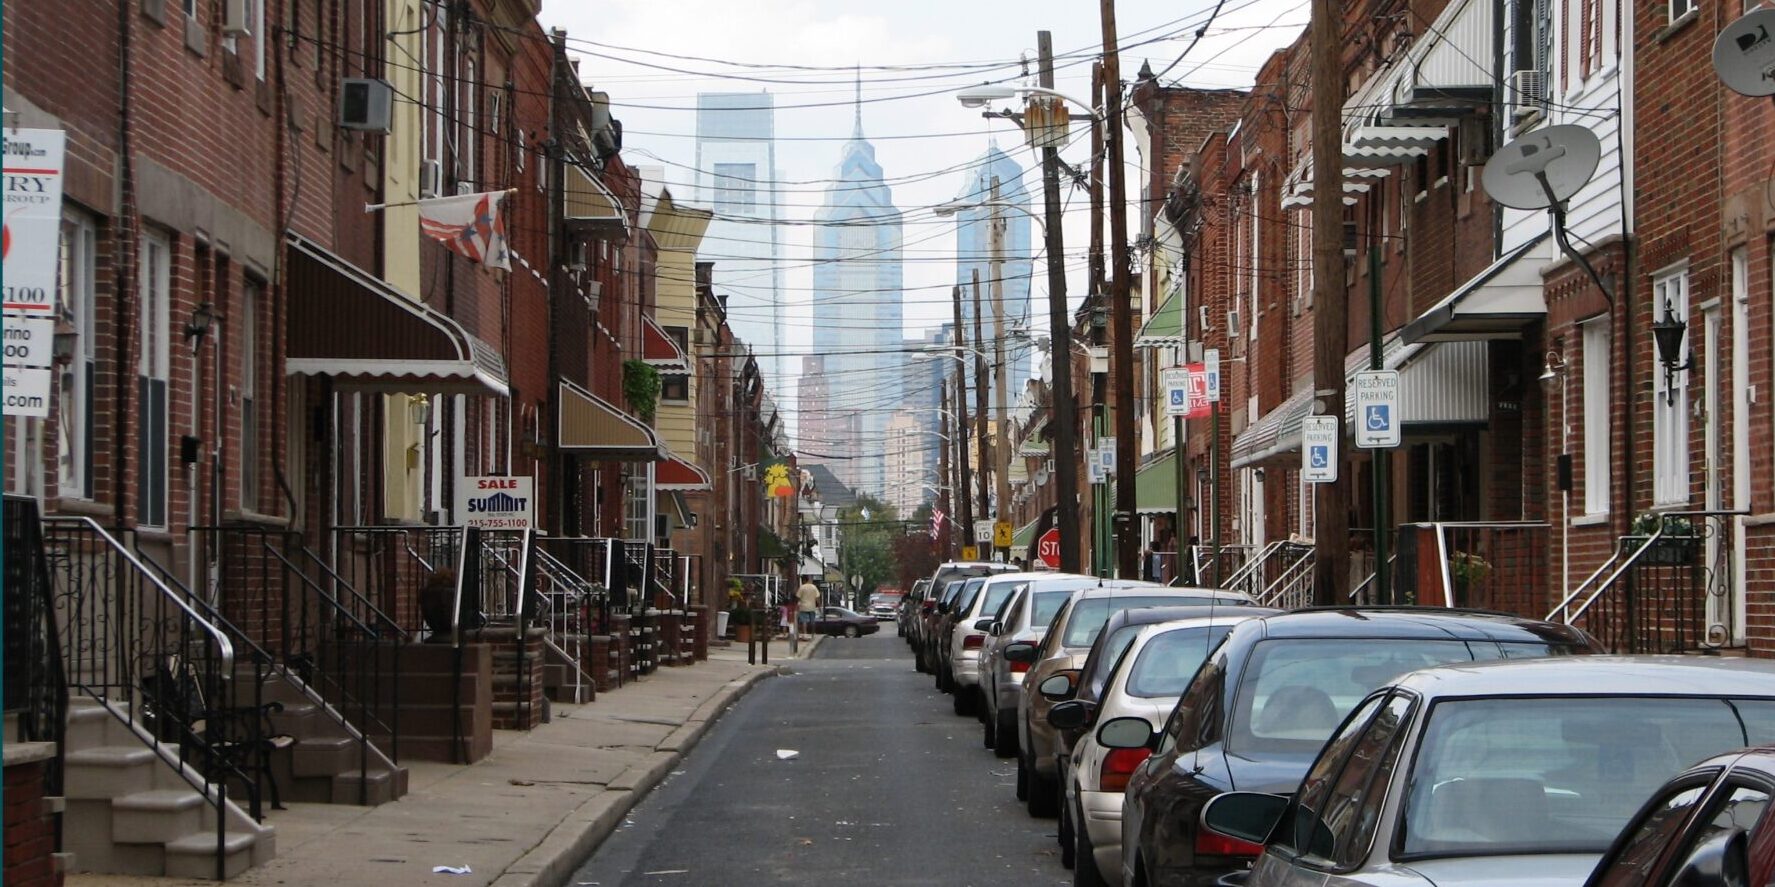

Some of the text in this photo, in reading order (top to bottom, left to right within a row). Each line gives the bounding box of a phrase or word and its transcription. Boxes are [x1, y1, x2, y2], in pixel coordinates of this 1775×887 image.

[3, 176, 52, 193] RY
[3, 286, 45, 303] 100
[1358, 379, 1396, 389] RESERVED
[1361, 391, 1394, 400] PARKING
[1305, 423, 1335, 431] RESERVED
[1306, 433, 1333, 442] PARKING
[477, 479, 517, 489] SALE
[467, 492, 527, 513] SUMMIT
[979, 531, 990, 541] 10
[1041, 541, 1060, 556] ST
